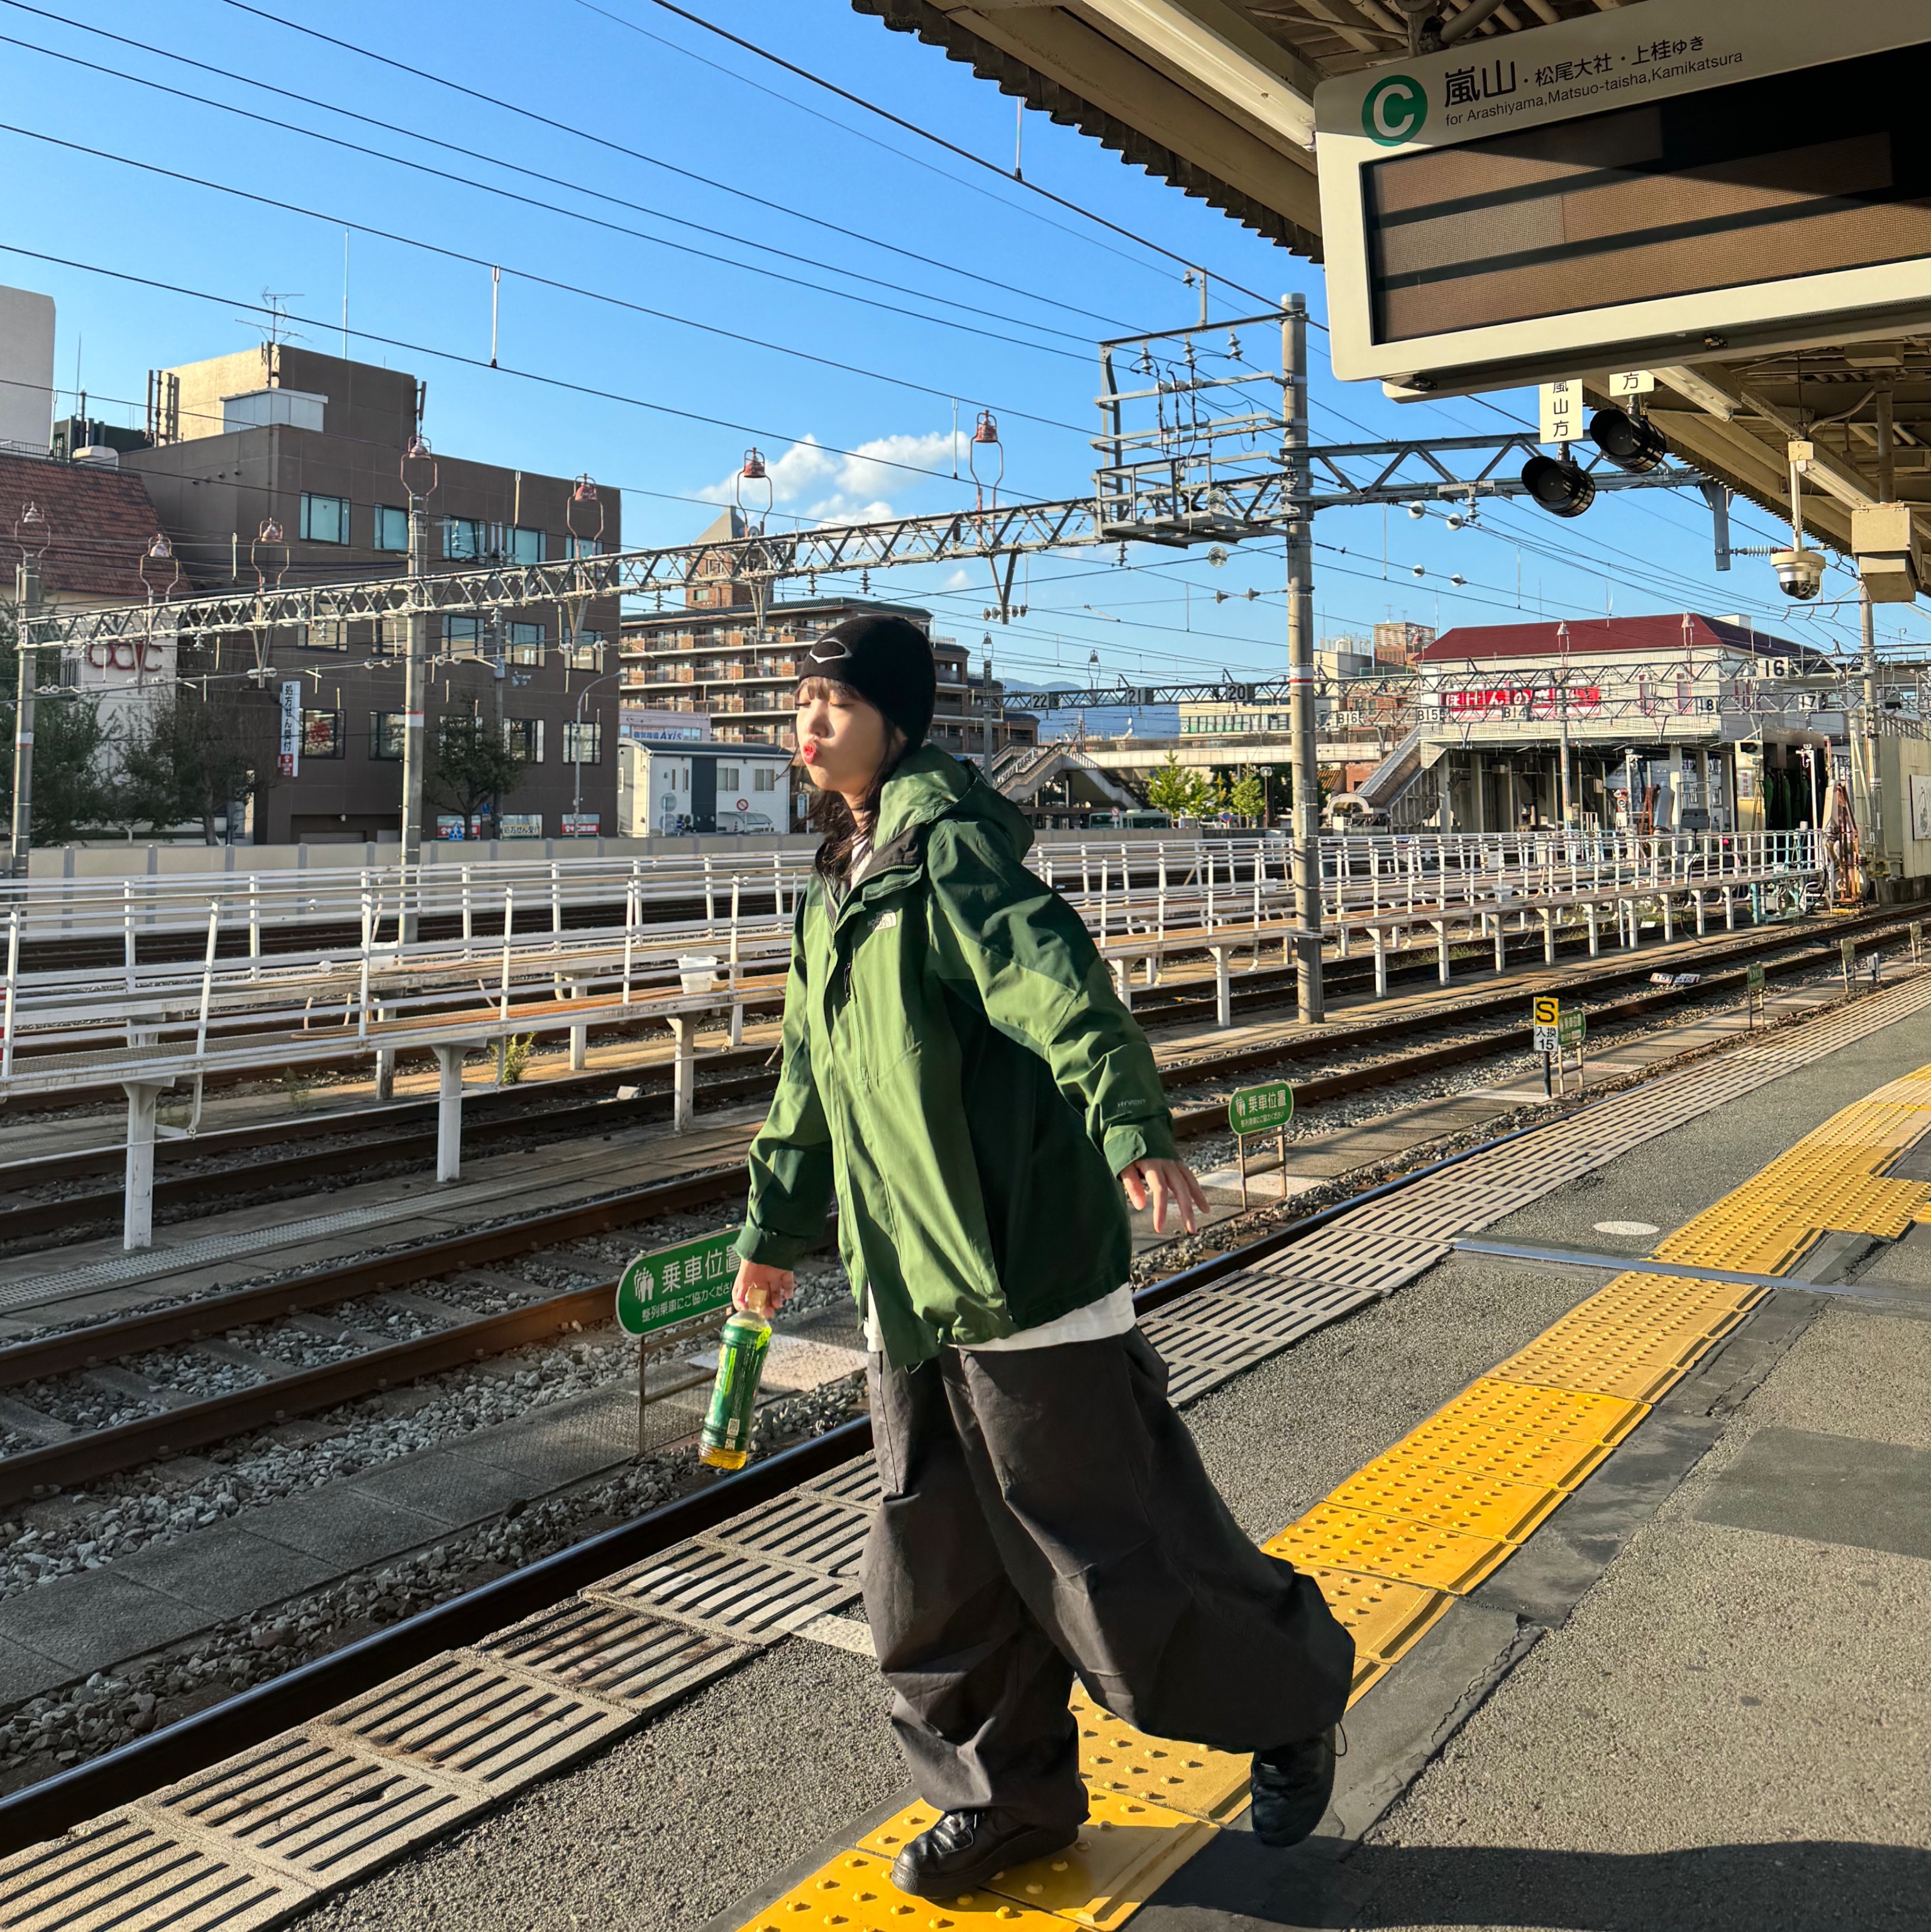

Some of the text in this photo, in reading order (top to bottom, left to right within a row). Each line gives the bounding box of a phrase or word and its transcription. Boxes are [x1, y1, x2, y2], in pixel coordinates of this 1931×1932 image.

[1445, 52, 1743, 126] for Arashiyama,Matsuo-taisha,Kamikatsura
[1373, 84, 1414, 137] C
[1765, 660, 1784, 677] 16
[1127, 689, 1141, 703] 21
[1228, 685, 1246, 701] 20
[1032, 694, 1048, 709] 22
[1700, 698, 1715, 711] 18
[1801, 696, 1816, 708] 17
[1337, 712, 1358, 724] B16
[1417, 709, 1439, 721] B15
[1503, 706, 1527, 718] B14
[1536, 1001, 1555, 1023] S
[1536, 1026, 1556, 1037] 入換
[1539, 1039, 1554, 1050] 15
[1249, 1089, 1286, 1113] 乗車位置
[661, 1245, 741, 1294] 乗車位置
